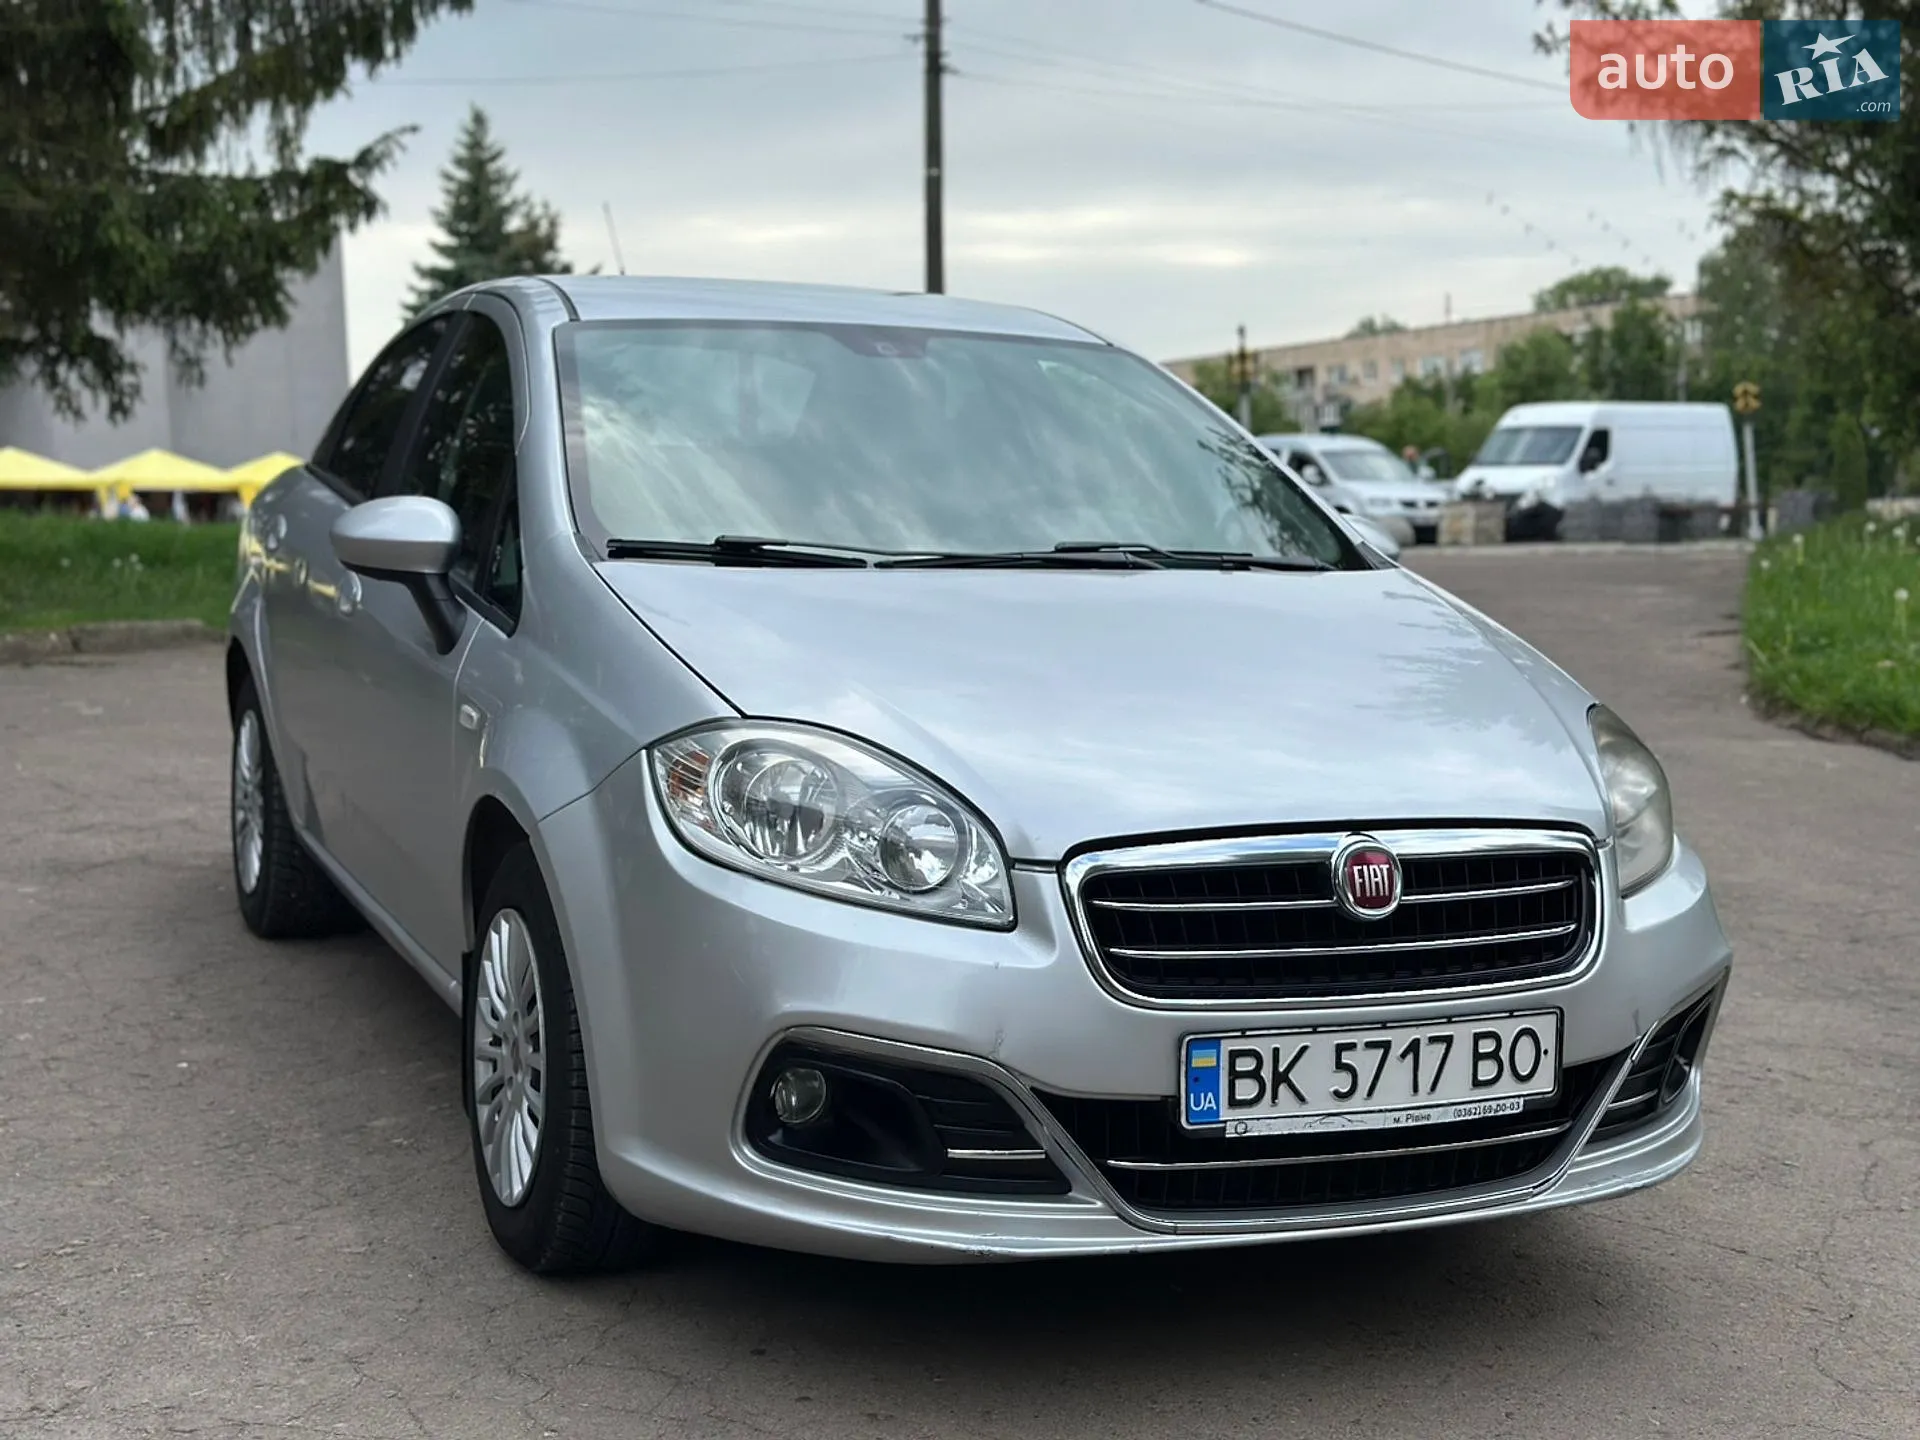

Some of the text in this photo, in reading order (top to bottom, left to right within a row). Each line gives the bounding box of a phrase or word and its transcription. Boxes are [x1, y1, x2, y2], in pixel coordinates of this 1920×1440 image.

[1353, 864, 1389, 897] FIAT
[1227, 1025, 1542, 1108] BK 5717 BO
[1190, 1092, 1217, 1111] UA
